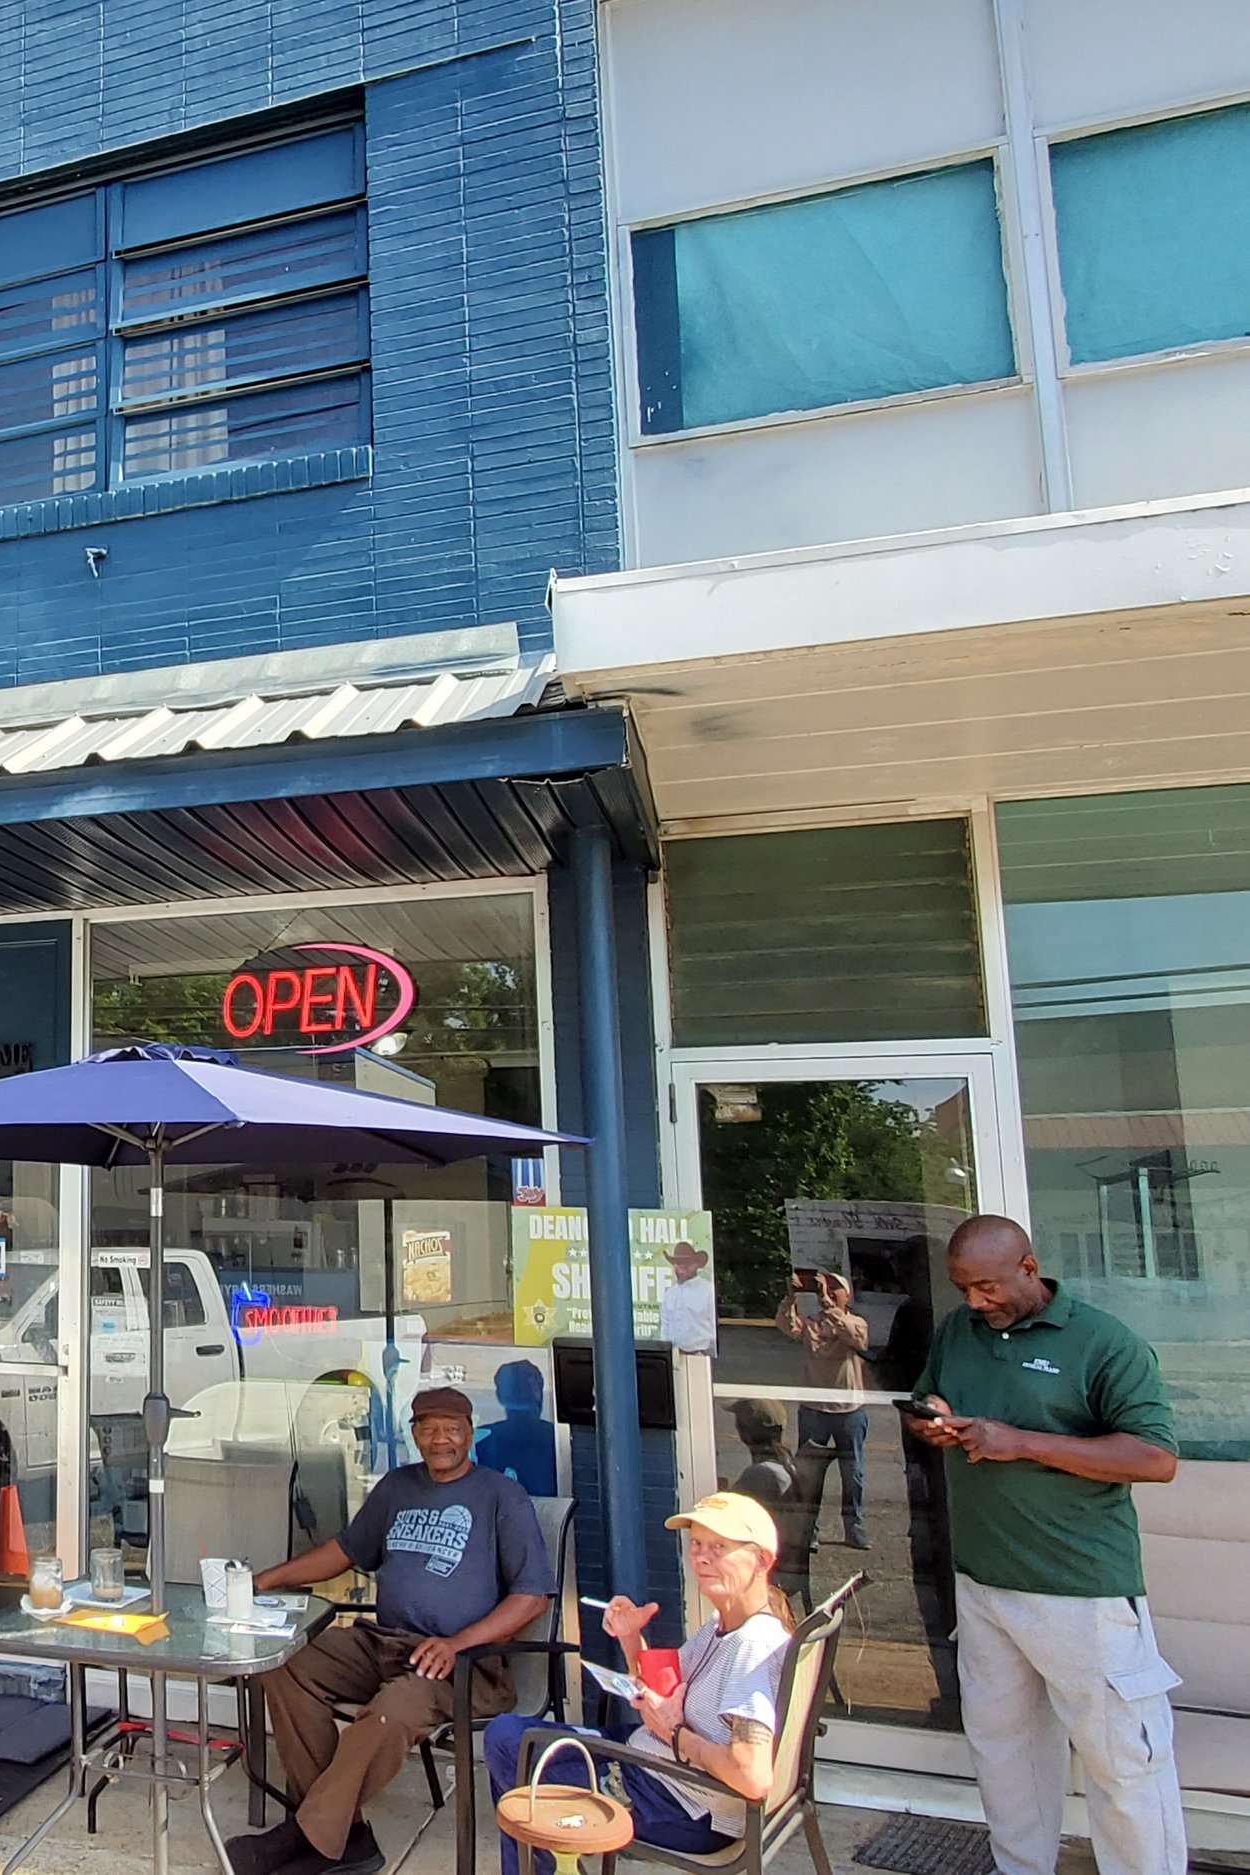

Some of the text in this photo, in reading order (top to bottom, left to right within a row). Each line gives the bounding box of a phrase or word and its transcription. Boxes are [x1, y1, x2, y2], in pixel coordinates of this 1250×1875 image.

[223, 963, 378, 1038] OPEN
[639, 1217, 693, 1245] HALL
[99, 1255, 136, 1266] No Smoking
[407, 1236, 445, 1264] NACHOS
[244, 1305, 339, 1335] SMOOTHIES
[396, 1509, 440, 1526] SUITS &
[386, 1521, 469, 1550] SNEAKERS
